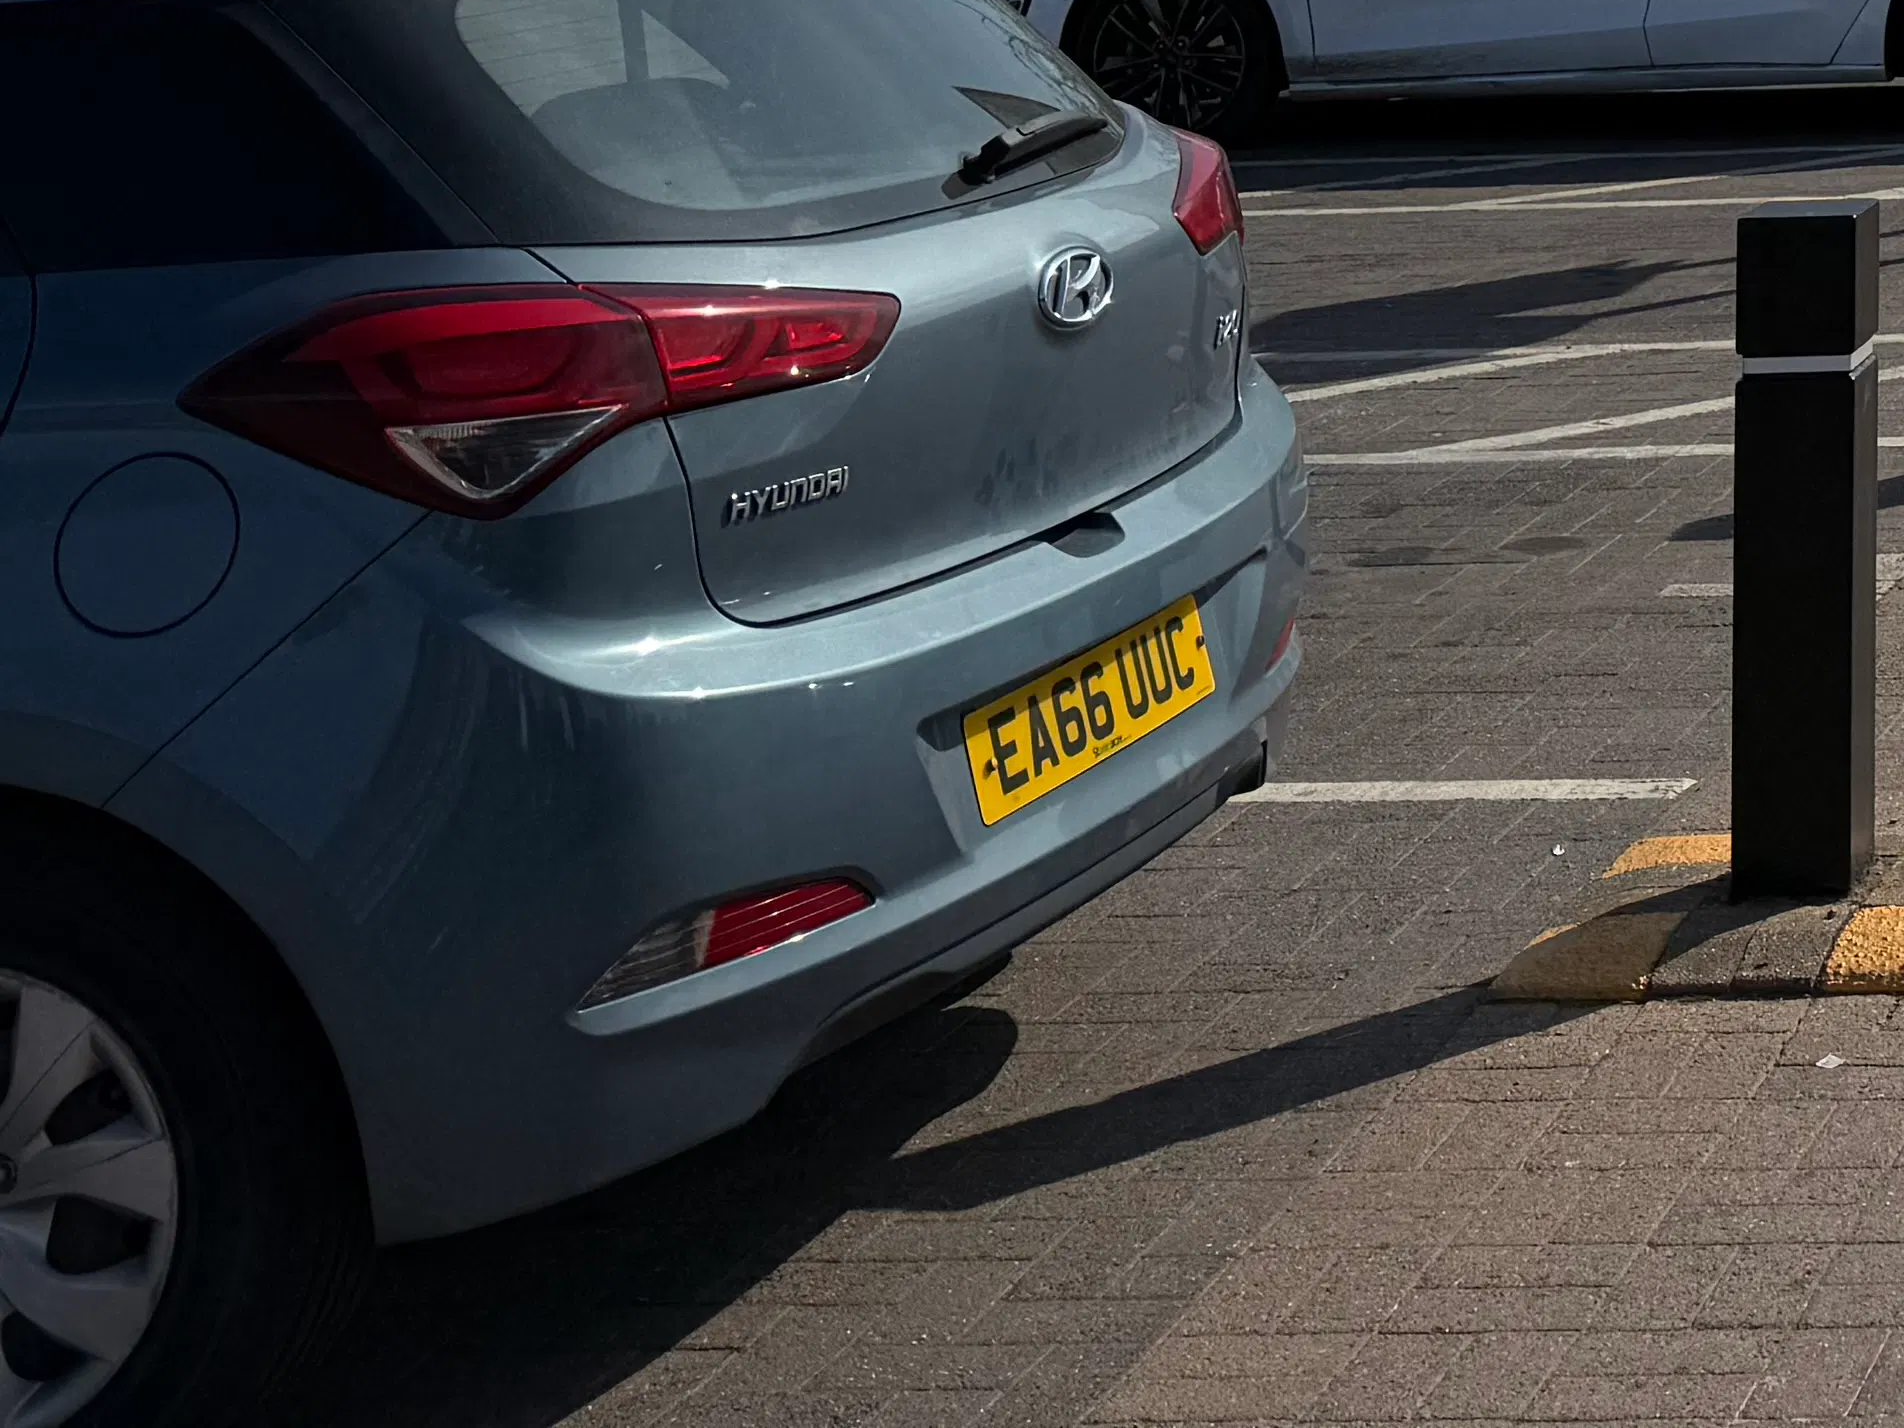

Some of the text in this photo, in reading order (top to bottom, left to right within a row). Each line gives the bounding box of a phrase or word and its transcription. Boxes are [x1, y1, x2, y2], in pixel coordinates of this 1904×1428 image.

[730, 465, 849, 522] HYUNDAI
[987, 616, 1195, 796] EA66 UUC
